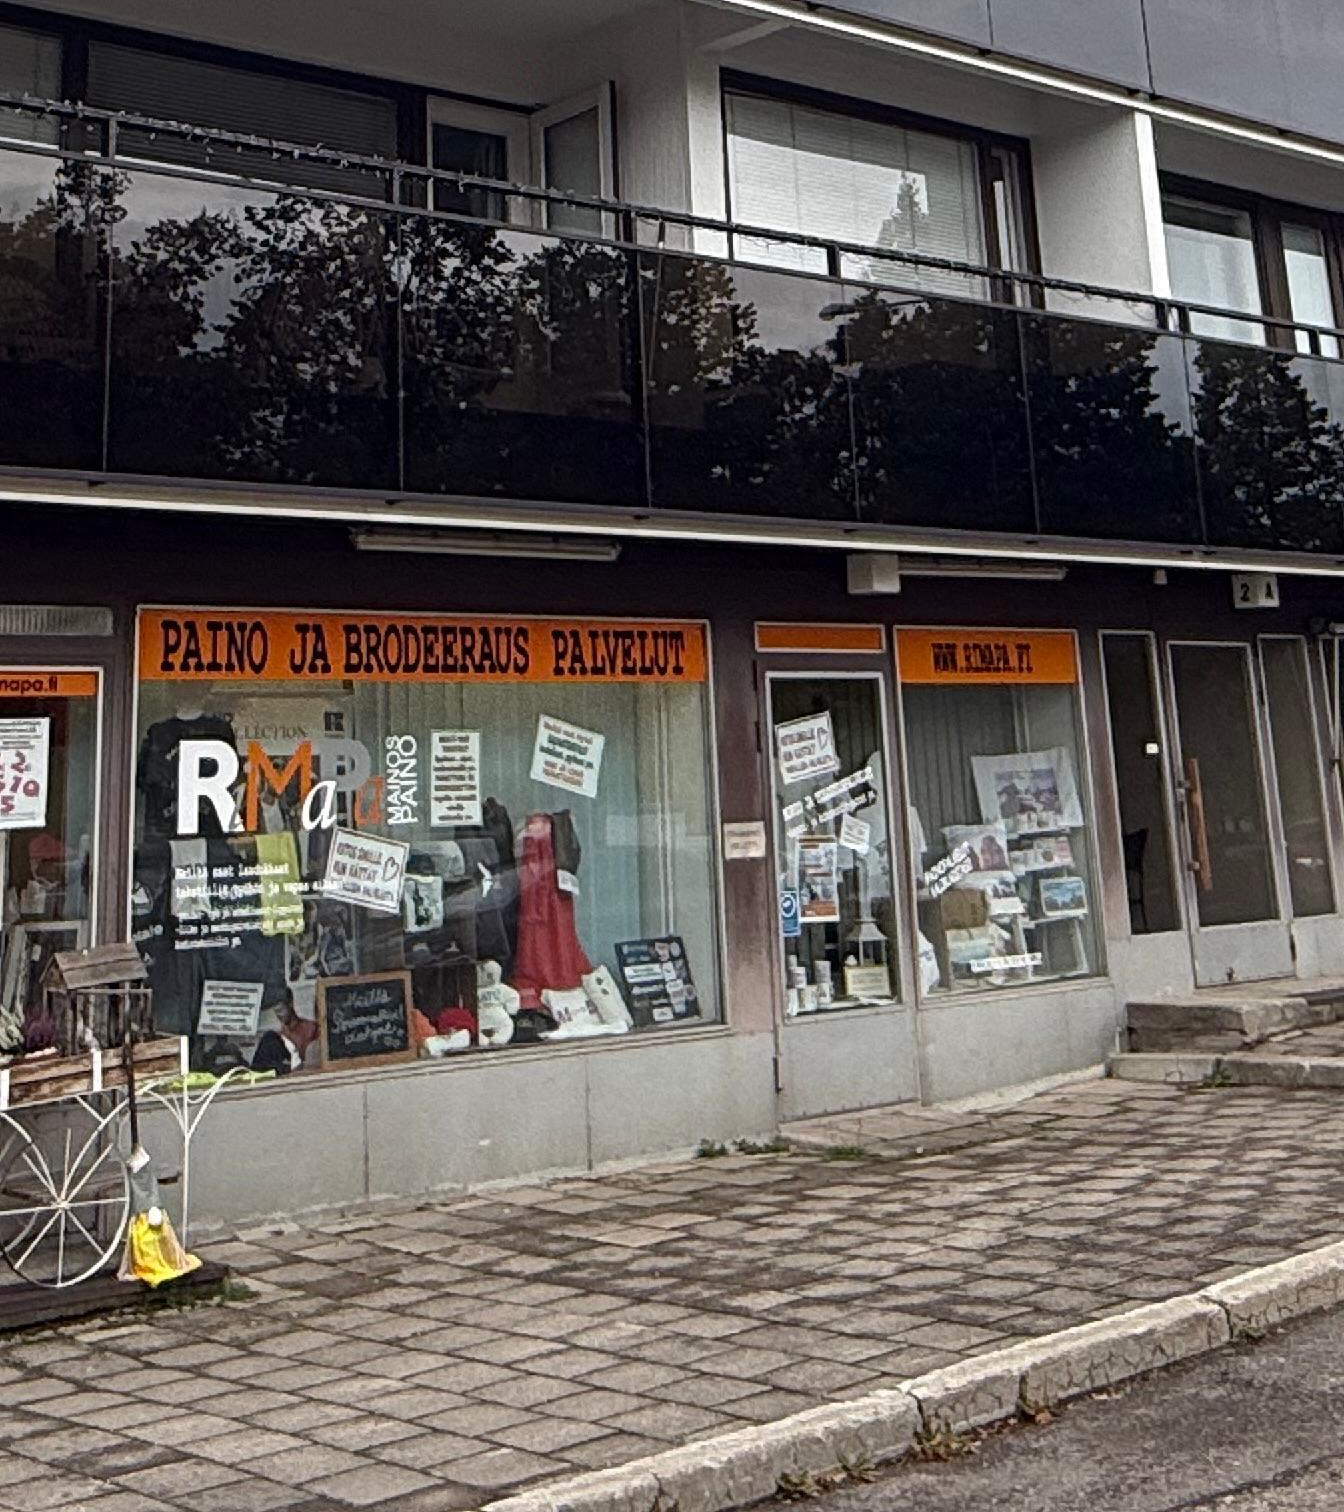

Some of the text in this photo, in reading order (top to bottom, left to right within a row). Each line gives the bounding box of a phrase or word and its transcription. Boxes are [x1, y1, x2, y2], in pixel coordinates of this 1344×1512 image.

[160, 619, 686, 676] PAINO JA BRODEERAUS PALVELUT
[386, 734, 400, 825] MAINOS
[399, 735, 418, 824] PAINO
